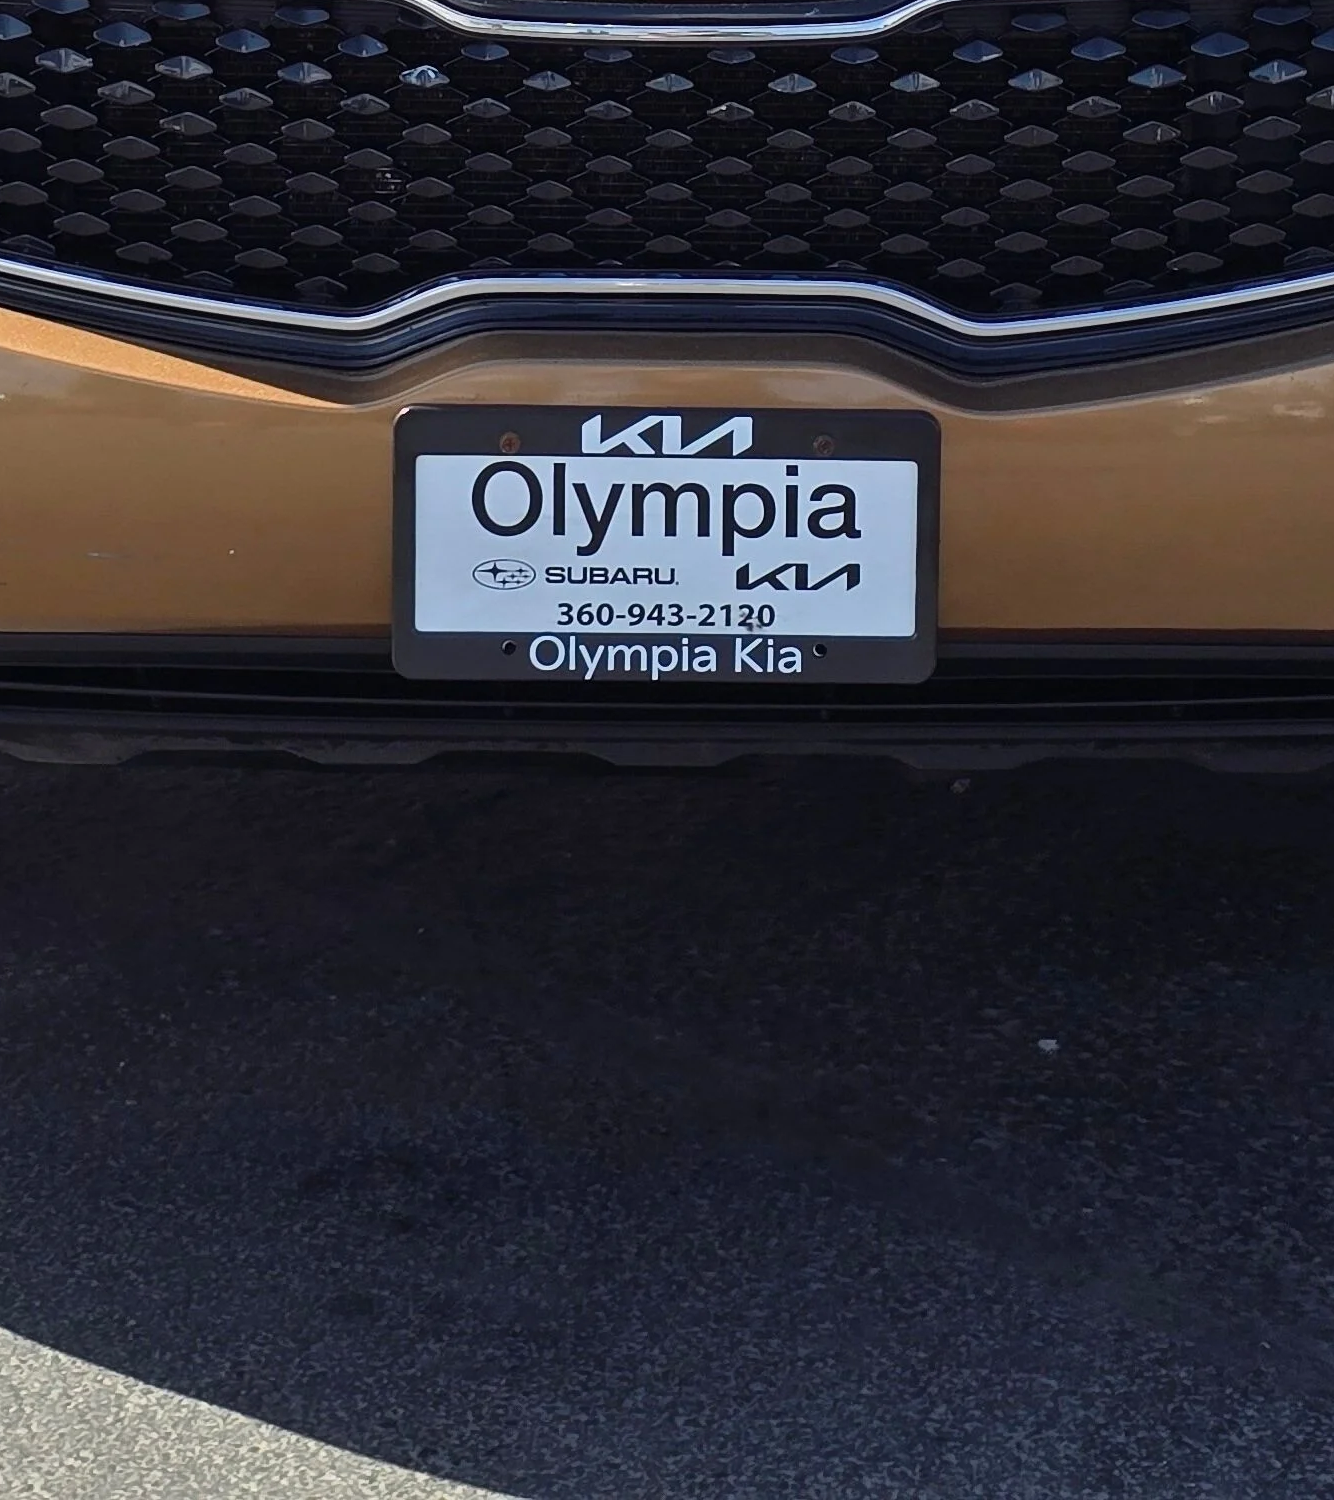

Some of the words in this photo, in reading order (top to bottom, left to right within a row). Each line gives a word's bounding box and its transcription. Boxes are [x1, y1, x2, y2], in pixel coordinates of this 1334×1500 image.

[471, 460, 862, 557] Olympia
[545, 566, 677, 586] SUBARU
[556, 602, 776, 628] 360-943-2120
[528, 635, 718, 681] Olympia
[734, 637, 804, 674] Kia
